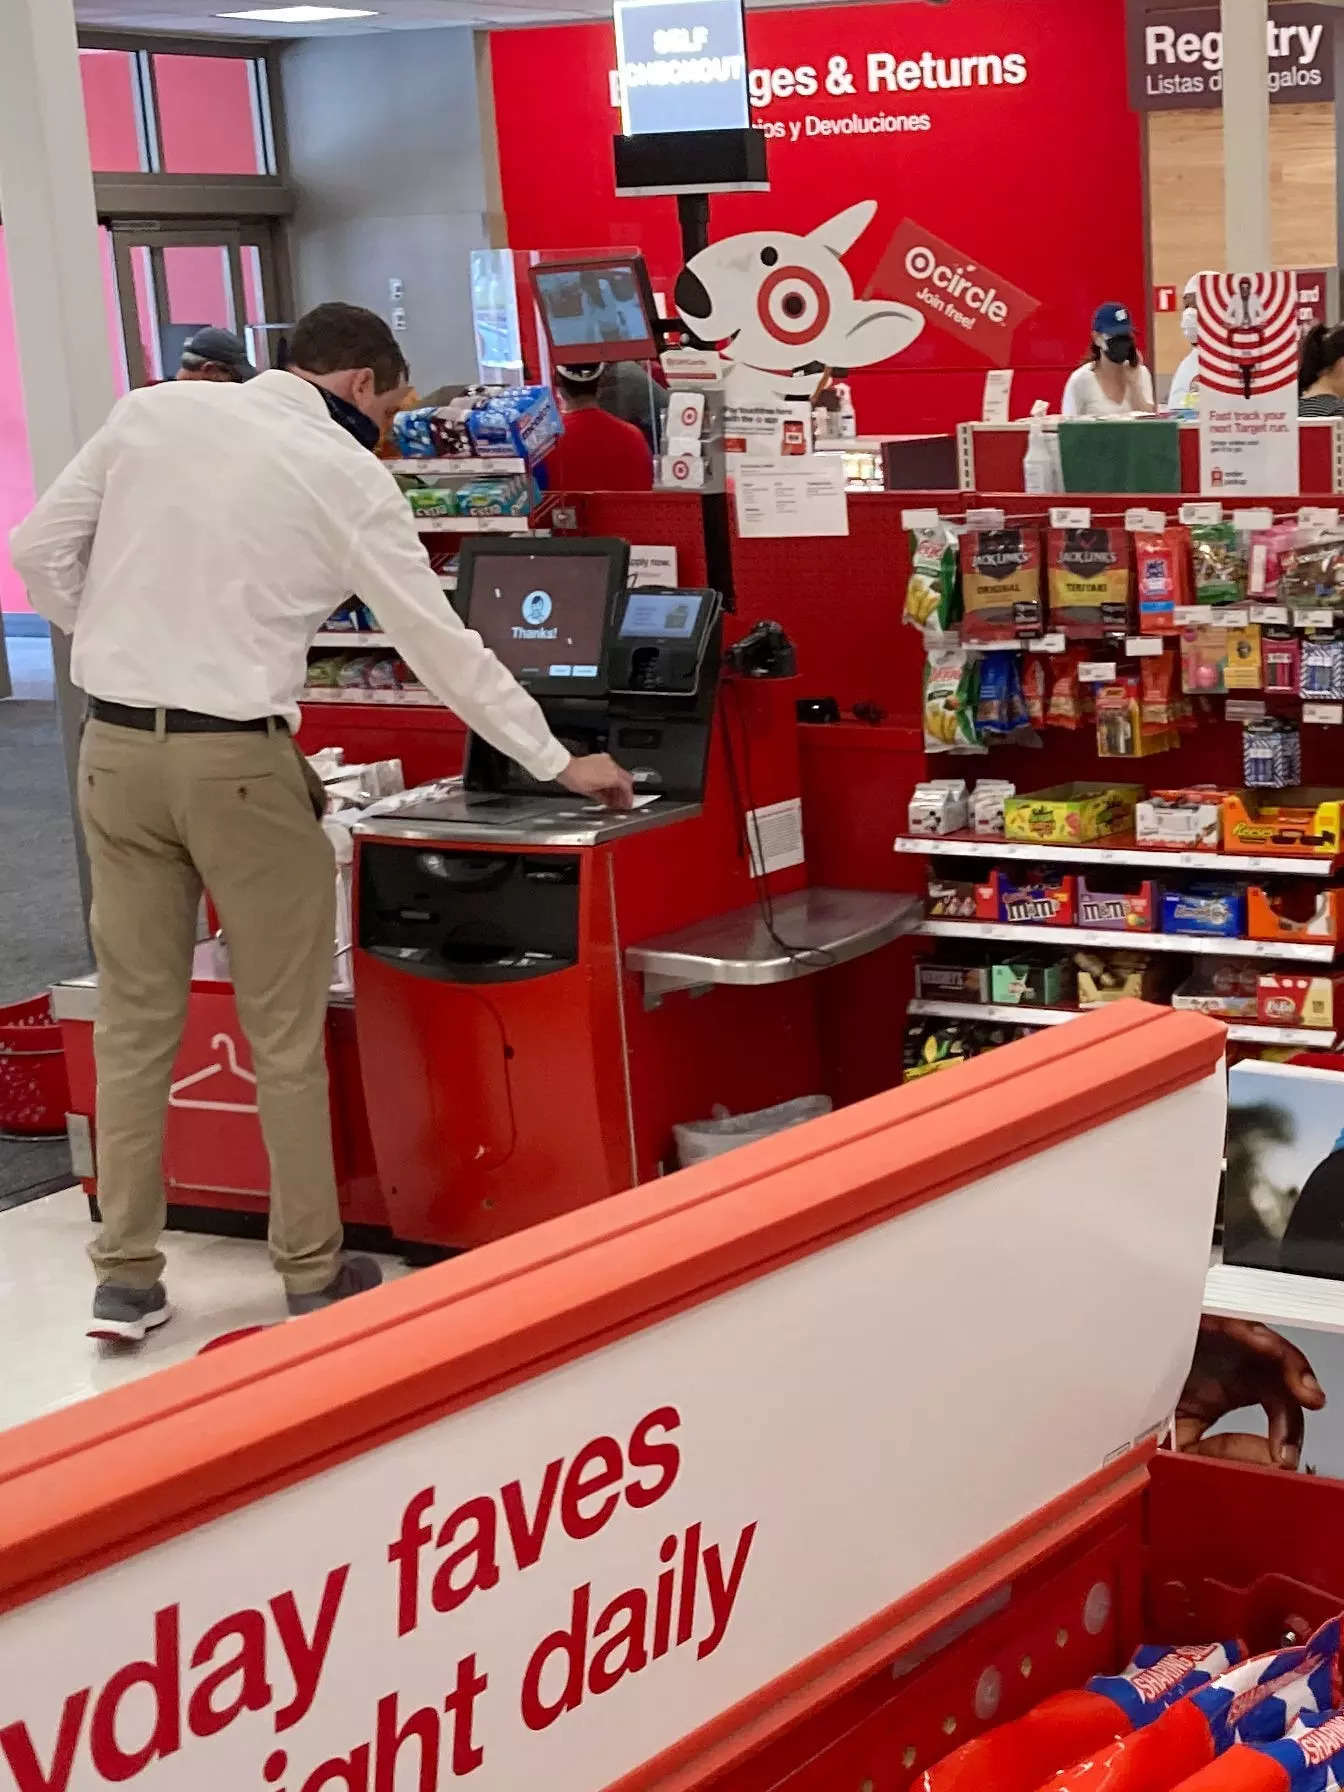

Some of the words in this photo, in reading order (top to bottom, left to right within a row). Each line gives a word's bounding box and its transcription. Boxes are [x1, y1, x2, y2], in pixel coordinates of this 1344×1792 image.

[1145, 20, 1323, 71] Regtry
[826, 54, 857, 95] &
[868, 51, 1027, 92] Returns
[1146, 74, 1204, 95] Listas
[805, 111, 931, 136] Devoluciones
[916, 287, 945, 312] Join
[932, 264, 1008, 323] circle
[387, 1405, 681, 1639] faves
[521, 1521, 759, 1732] daily
